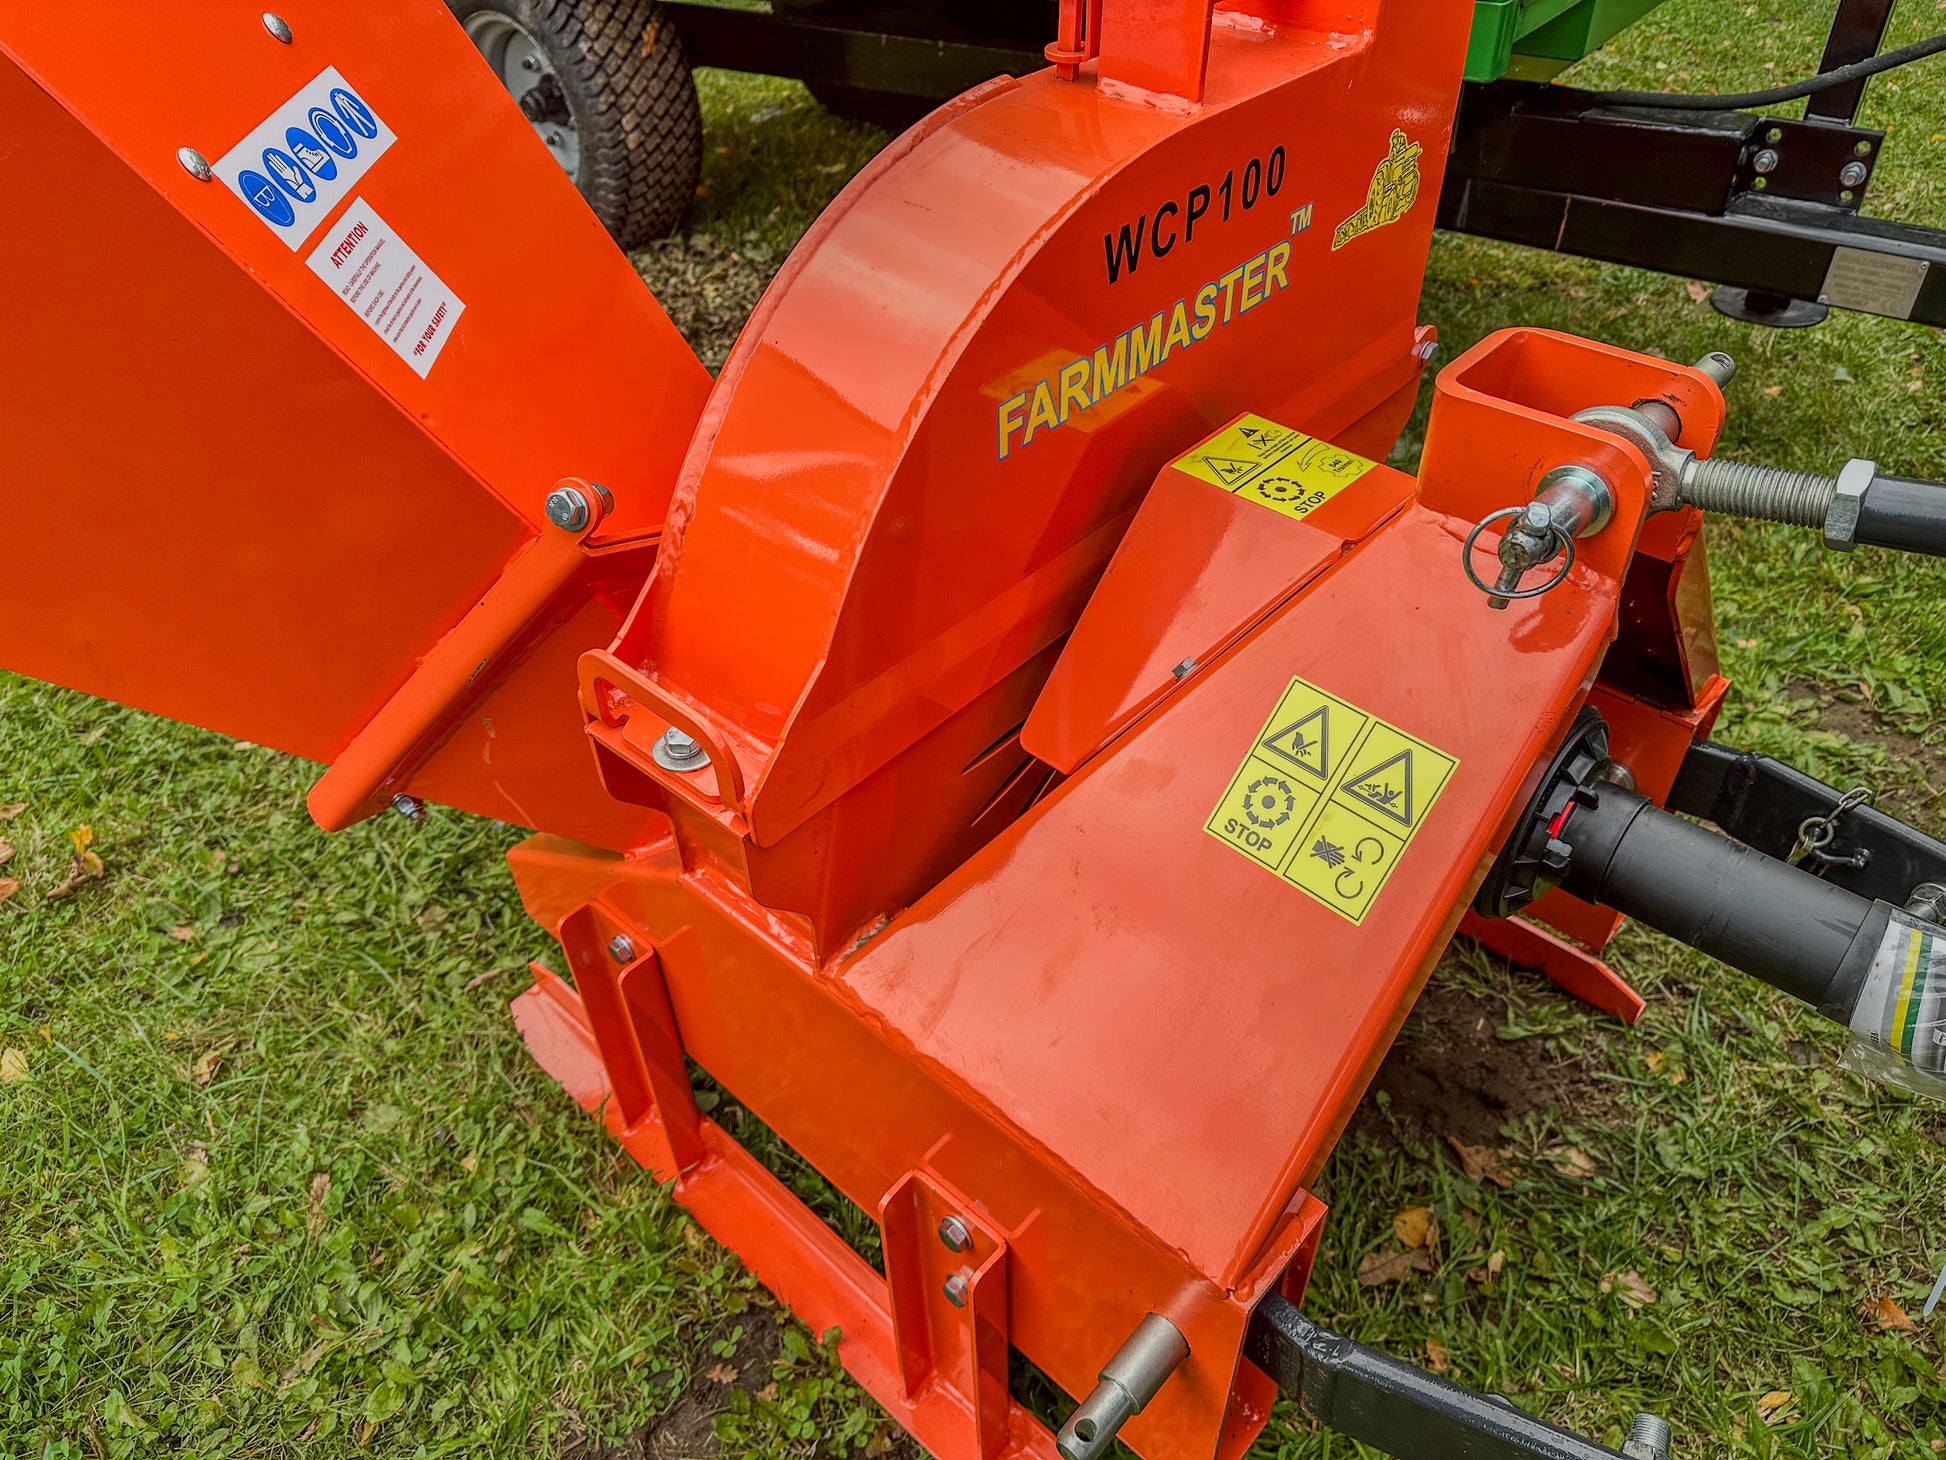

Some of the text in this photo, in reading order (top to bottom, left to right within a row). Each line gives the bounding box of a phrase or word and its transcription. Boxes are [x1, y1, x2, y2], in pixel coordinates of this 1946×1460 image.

[1103, 144, 1286, 285] WCP100
[330, 221, 368, 269] ATTENTION
[422, 324, 436, 343] YOUR
[998, 201, 1314, 463] FARMMASTER TM
[1294, 491, 1326, 514] STOP
[1224, 818, 1272, 851] STOP
